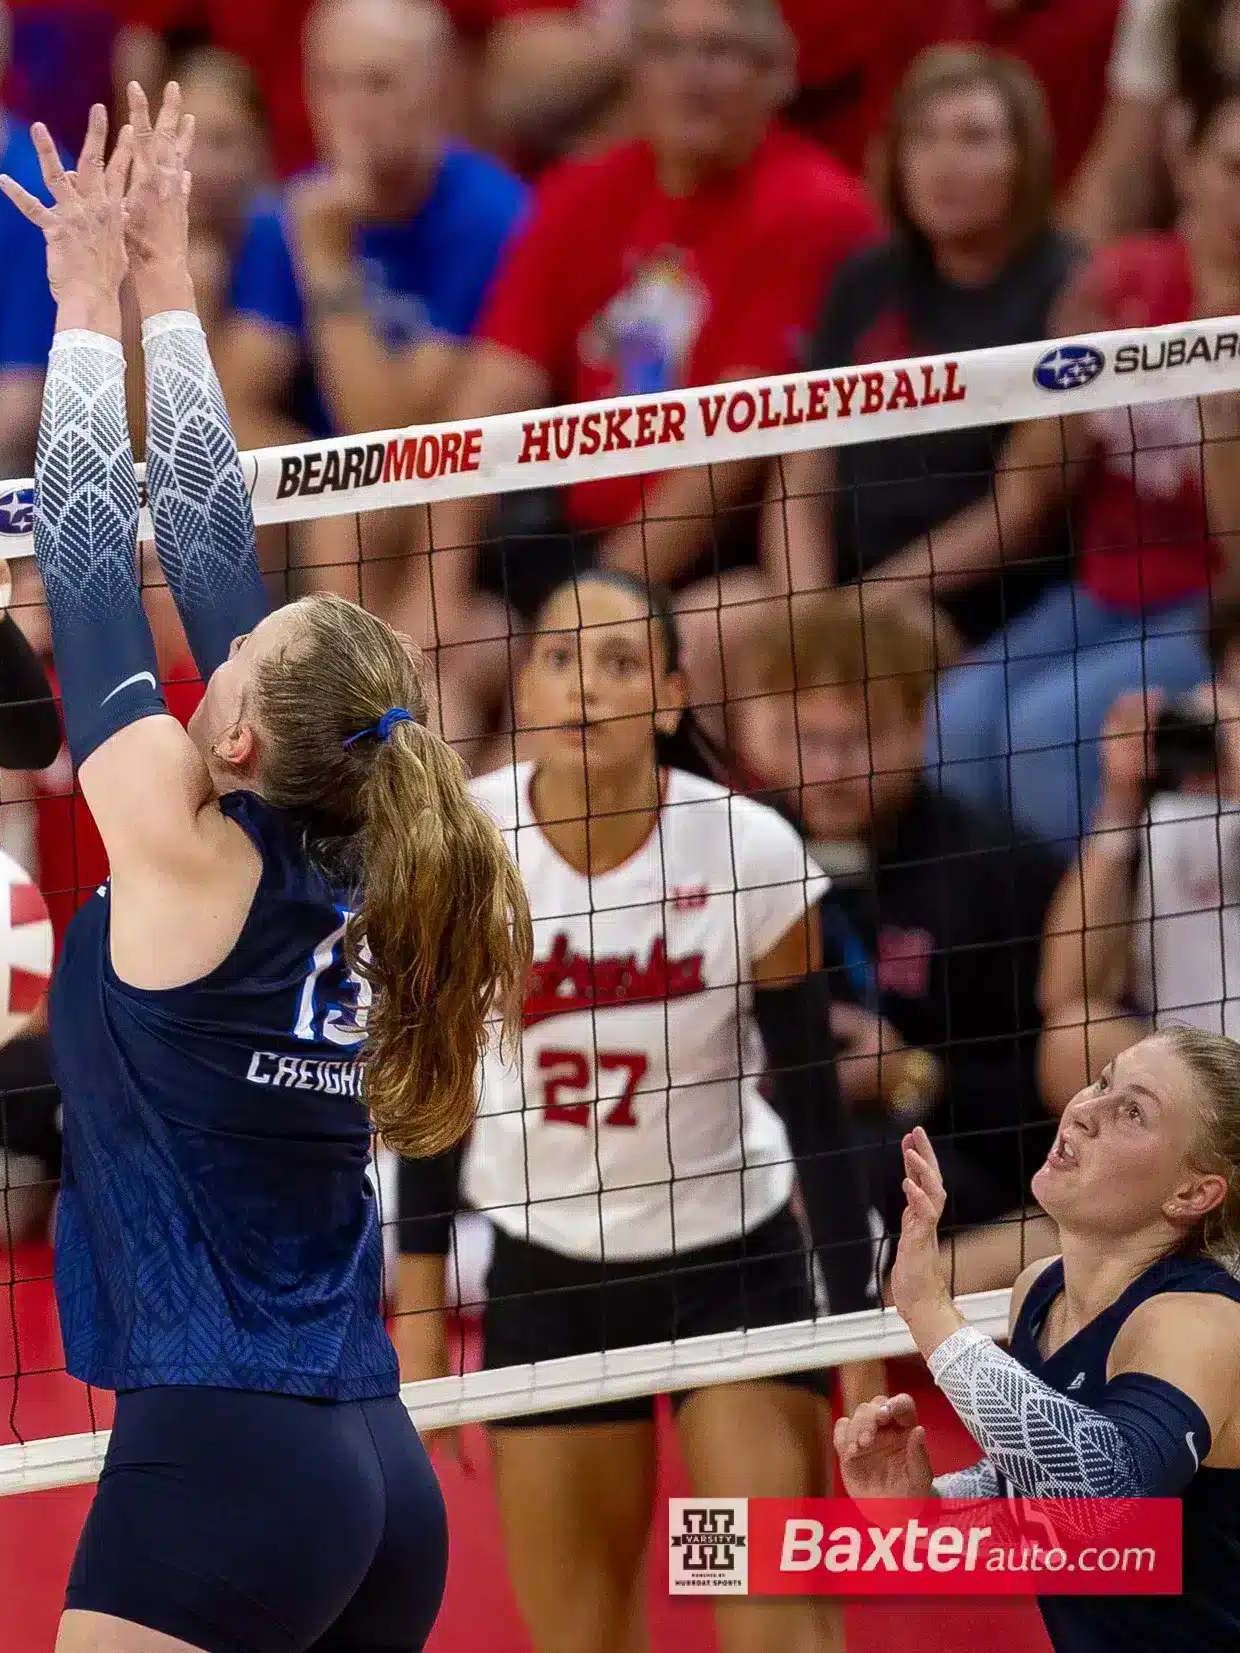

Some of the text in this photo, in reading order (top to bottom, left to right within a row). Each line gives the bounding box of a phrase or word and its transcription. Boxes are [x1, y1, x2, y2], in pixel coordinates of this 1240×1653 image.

[1114, 333, 1240, 375] SUBAR
[276, 362, 967, 500] BEARDMORE HUSKER VOLLEYBALL
[246, 1051, 368, 1097] CREIGHT
[538, 1050, 647, 1128] 27
